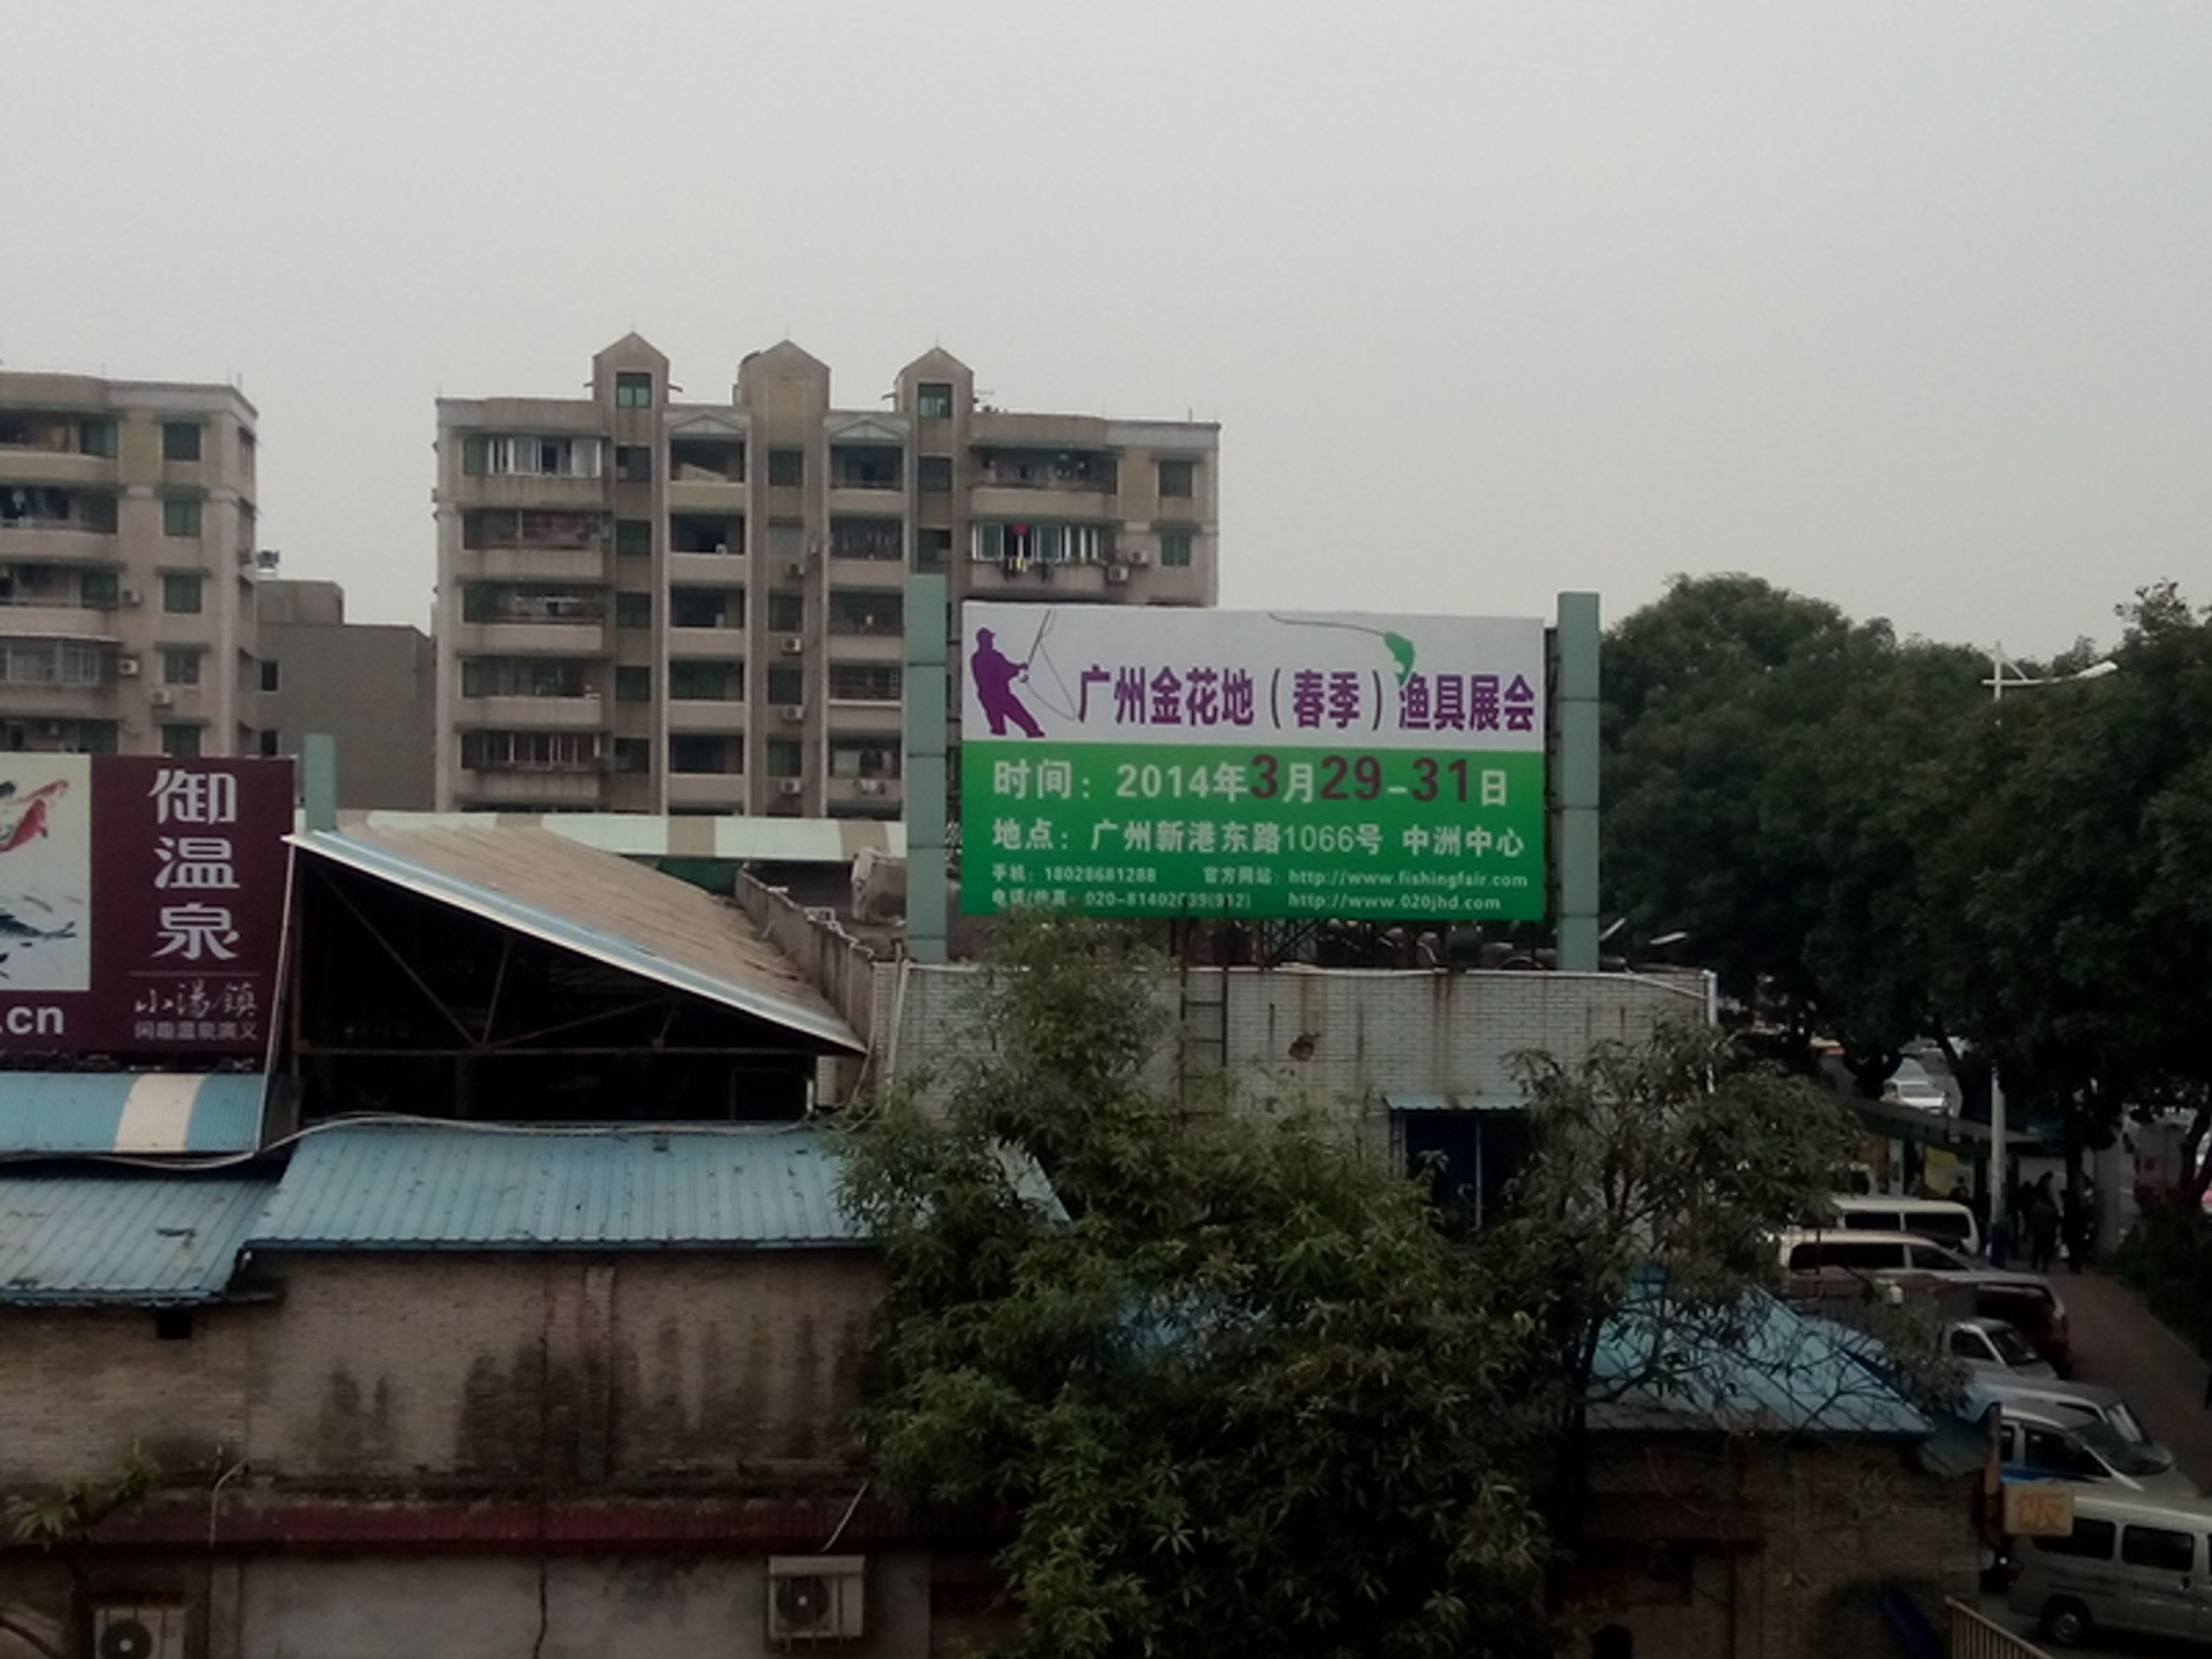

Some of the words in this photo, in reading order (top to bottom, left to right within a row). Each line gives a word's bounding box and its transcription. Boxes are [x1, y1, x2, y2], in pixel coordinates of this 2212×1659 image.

[147, 769, 240, 960] 御温泉
[1091, 818, 1383, 855] 广州新港东路1066号
[1403, 825, 1525, 857] 中洲中心
